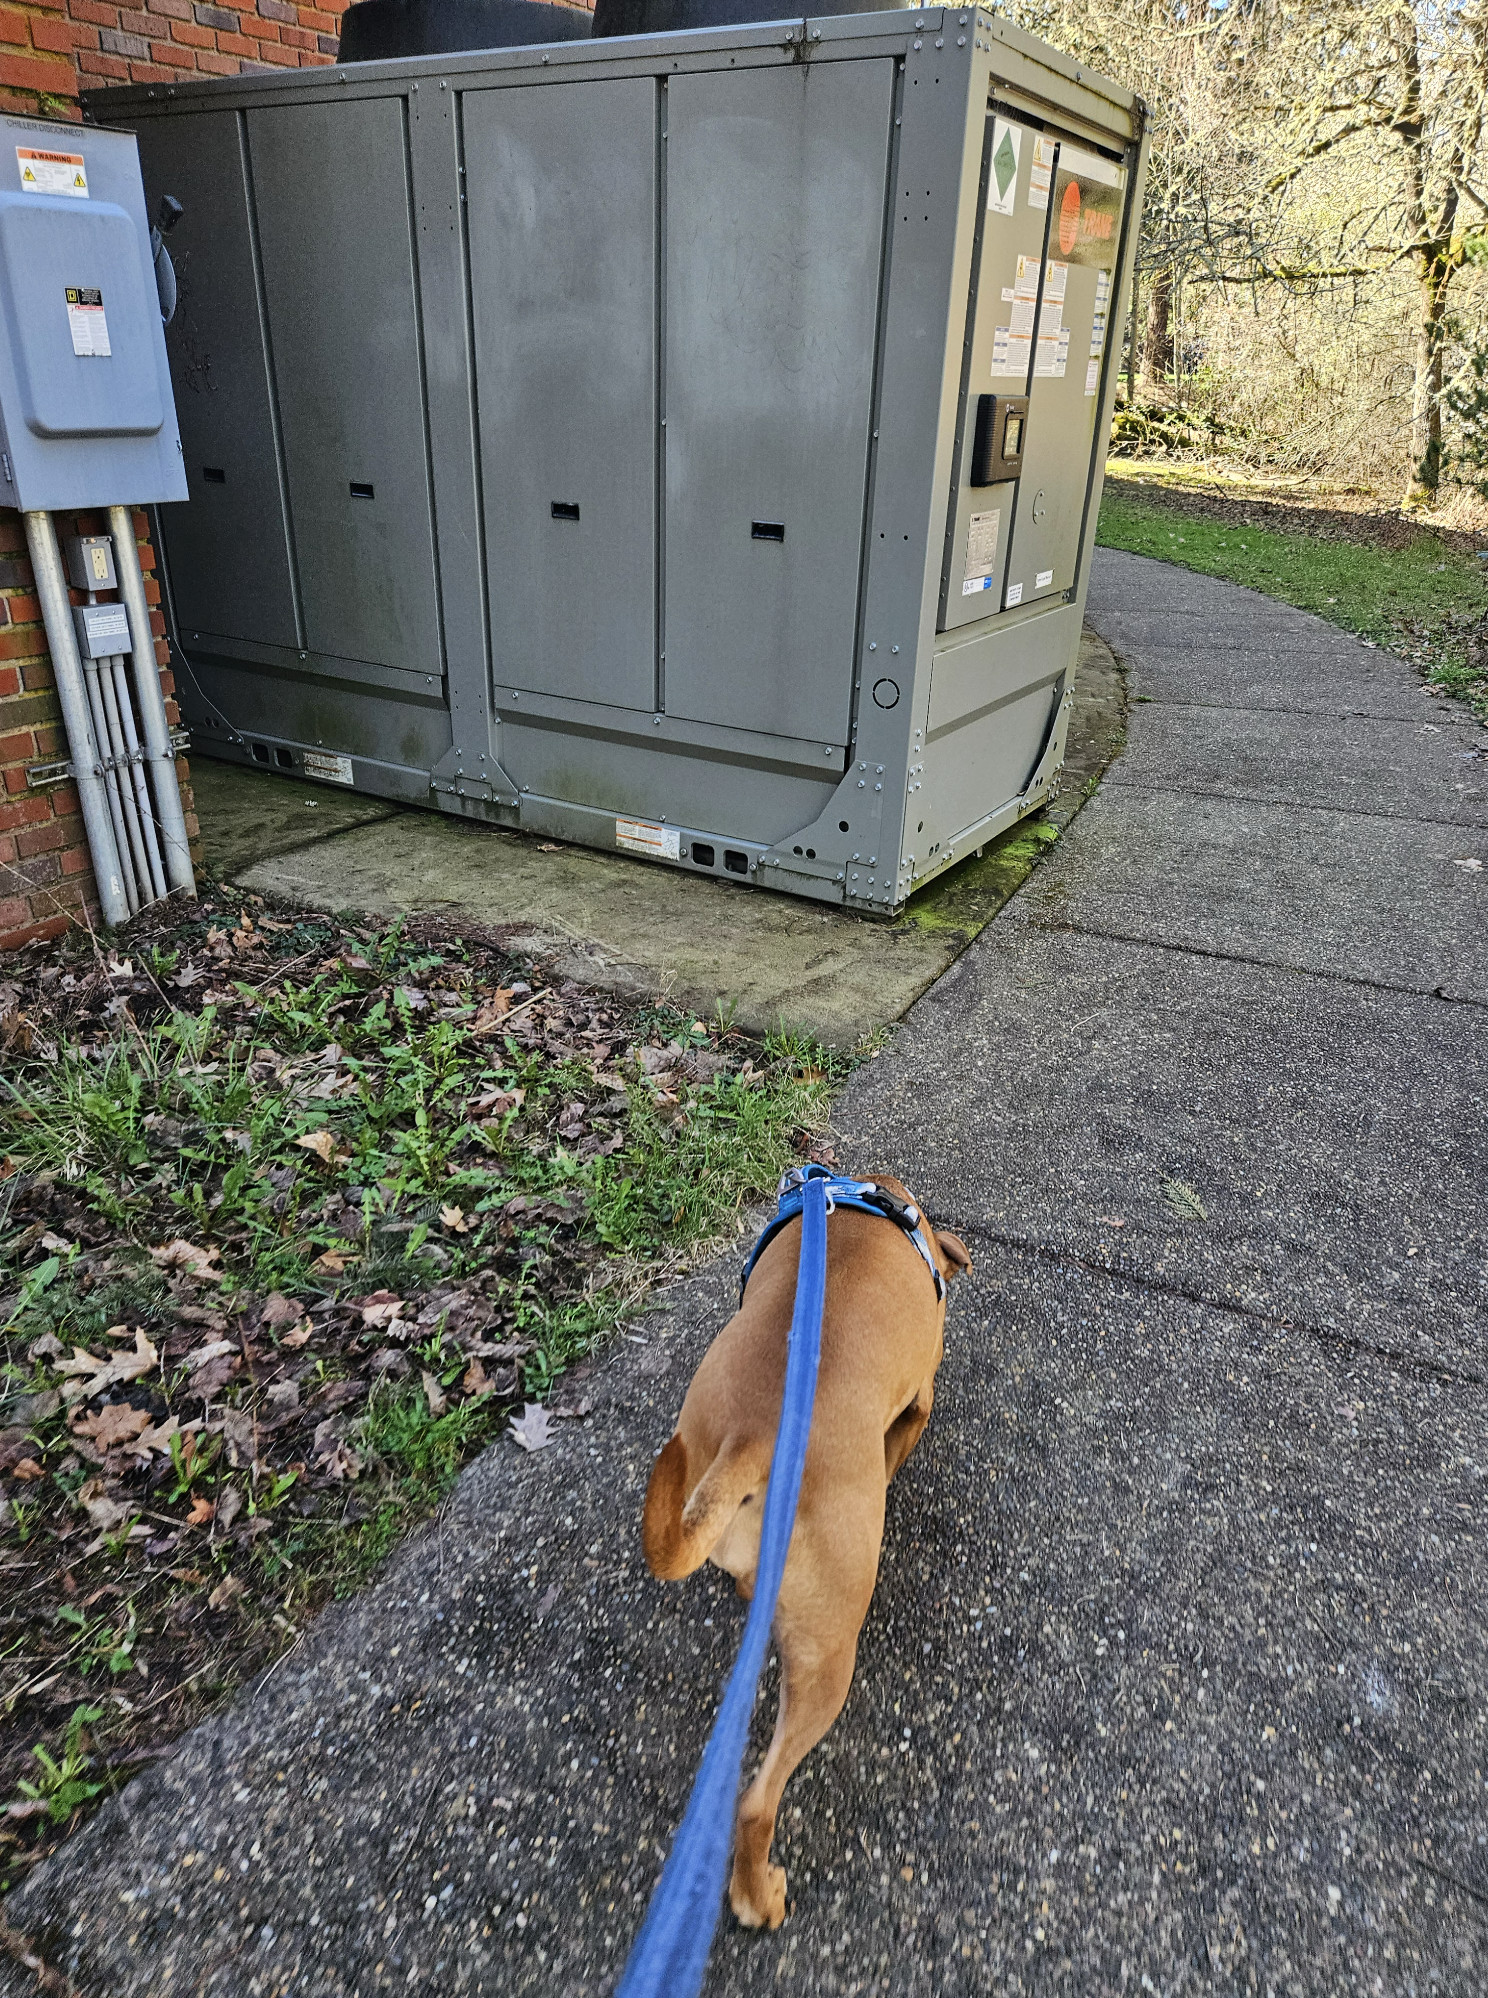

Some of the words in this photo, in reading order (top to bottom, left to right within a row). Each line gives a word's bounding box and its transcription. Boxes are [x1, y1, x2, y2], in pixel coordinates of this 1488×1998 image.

[6, 119, 37, 131] CHILLER
[39, 124, 84, 136] DISCONNECT
[39, 153, 71, 163] WARNING
[1083, 208, 1112, 239] TRANE
